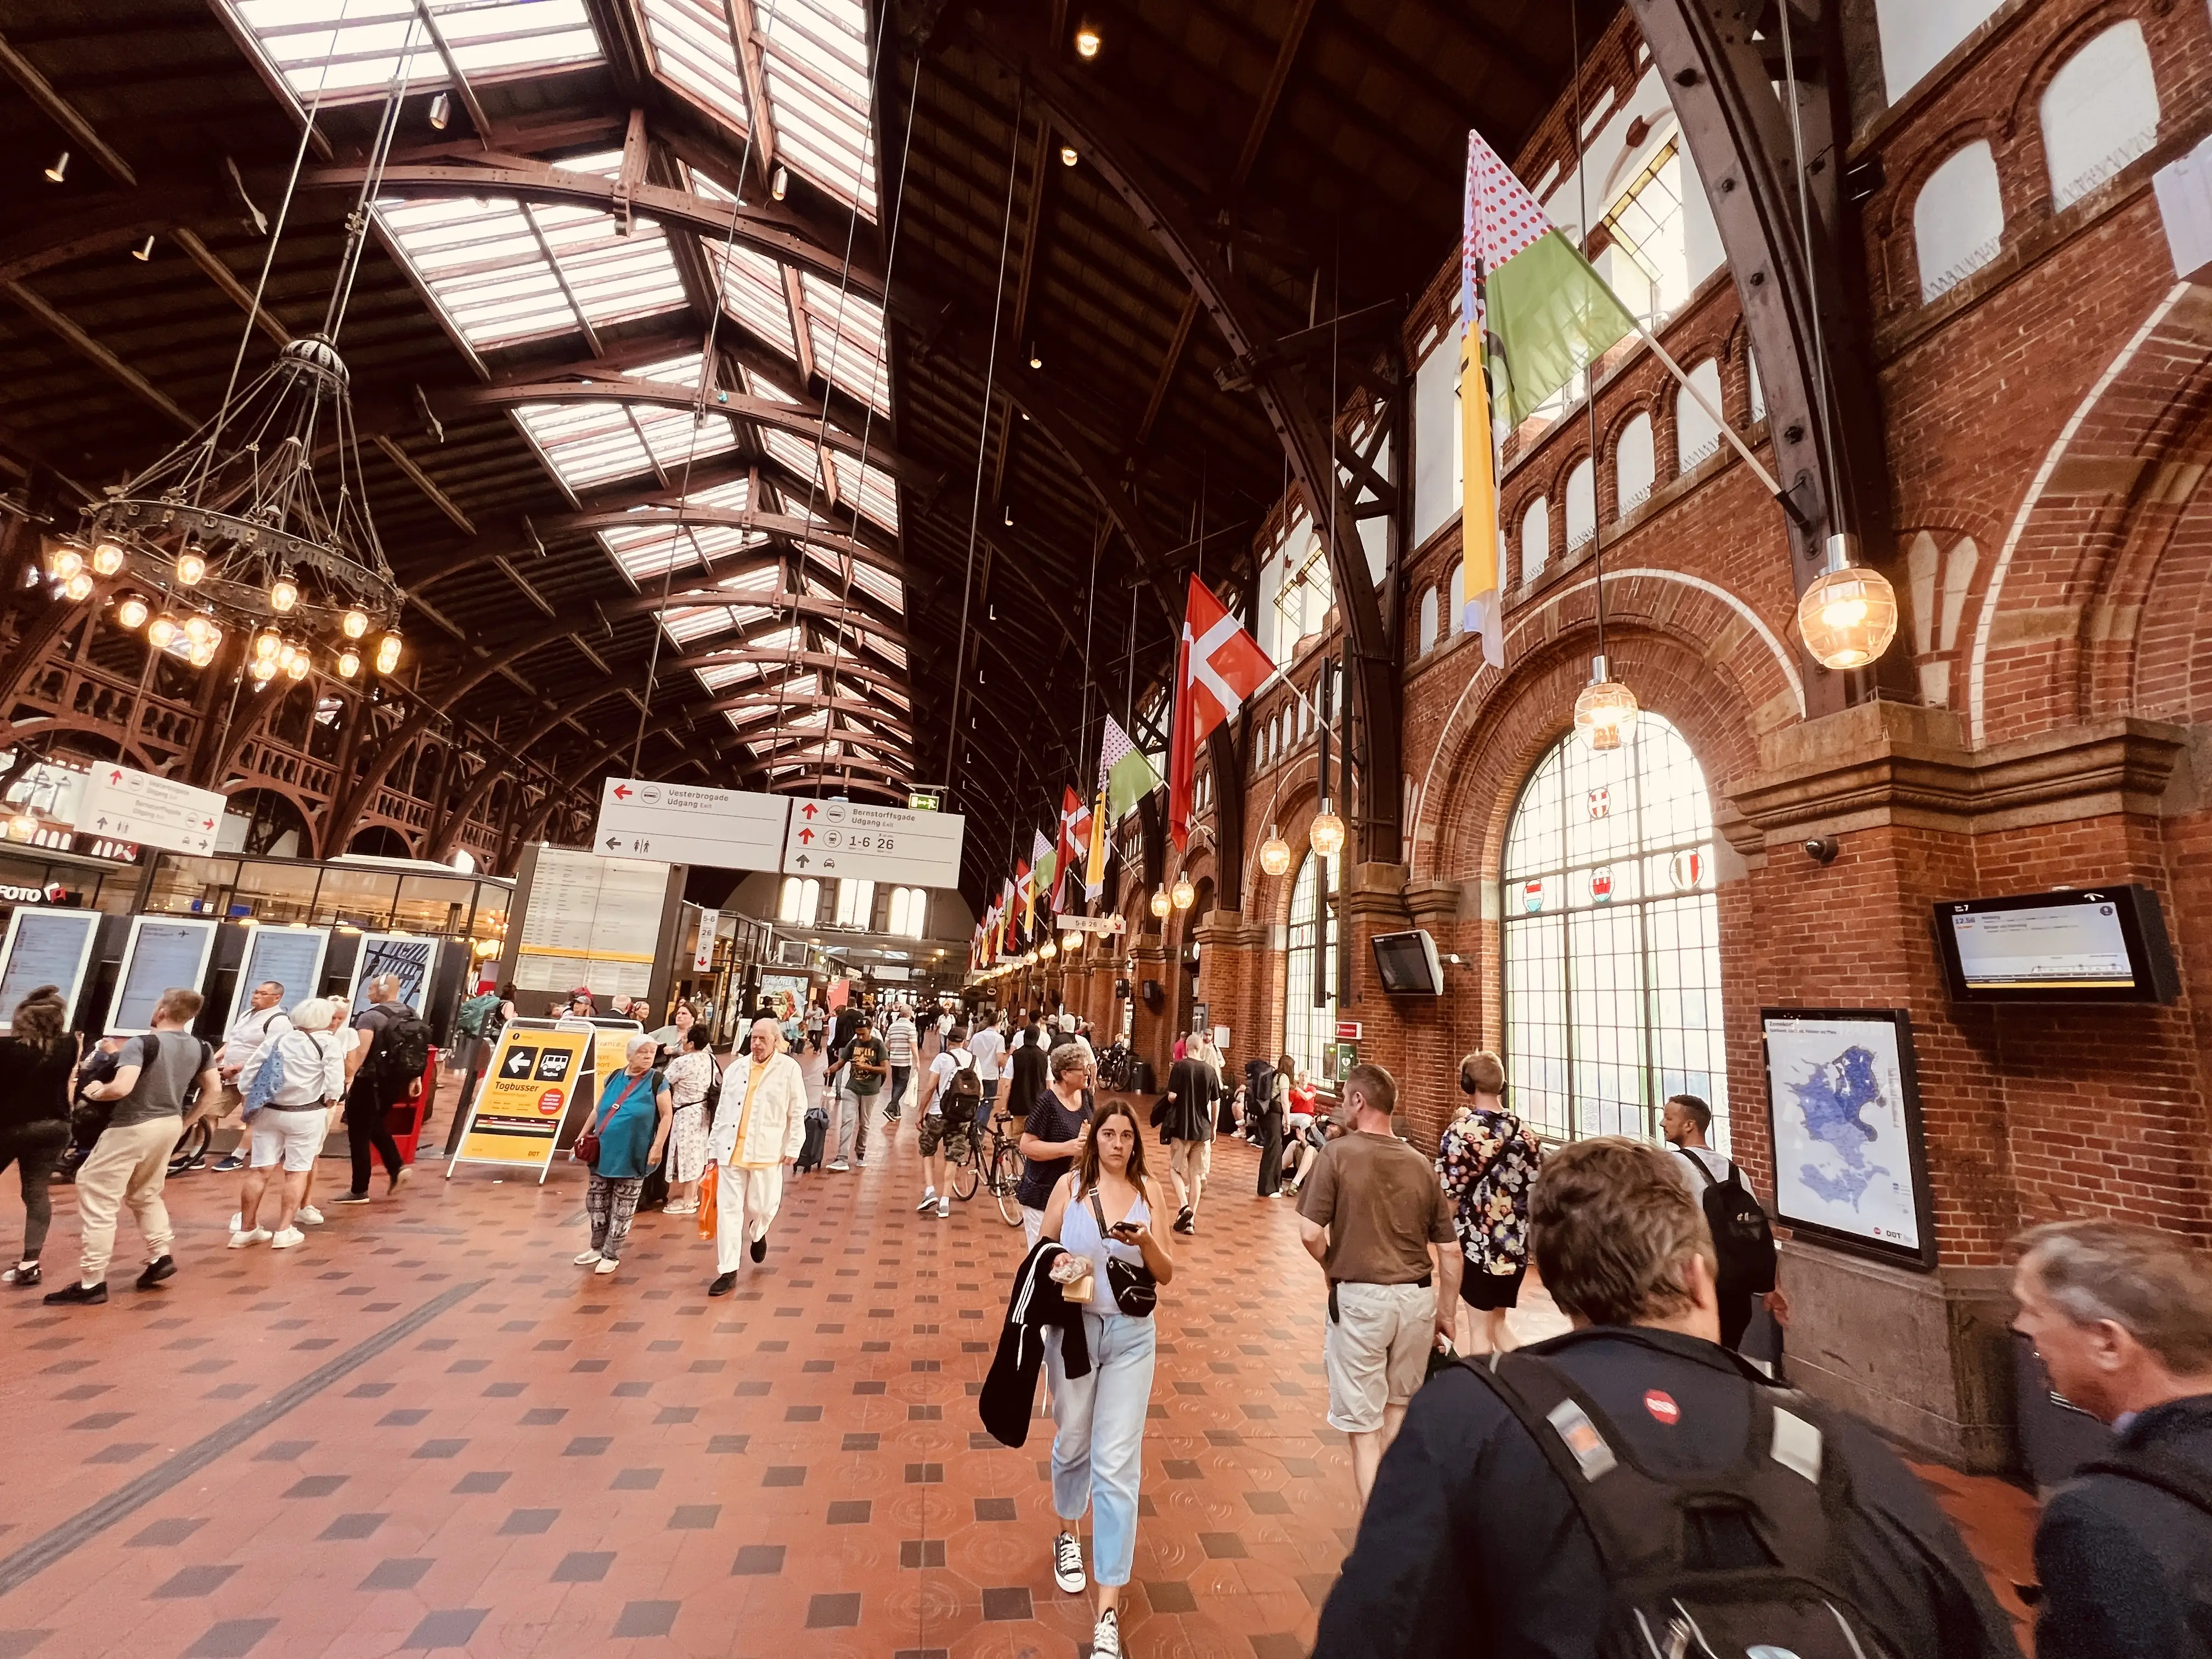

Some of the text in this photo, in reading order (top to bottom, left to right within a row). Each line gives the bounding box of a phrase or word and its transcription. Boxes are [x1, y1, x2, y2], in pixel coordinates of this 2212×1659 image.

[669, 789, 729, 802] Vesterbrogade
[667, 798, 698, 809] Udgang
[853, 809, 916, 821] Bernstorffsgade
[851, 817, 881, 827] Udgang
[849, 836, 894, 850] 1-6 26
[495, 1081, 539, 1092] Togbusser
[1886, 1230, 1901, 1239] DOT
